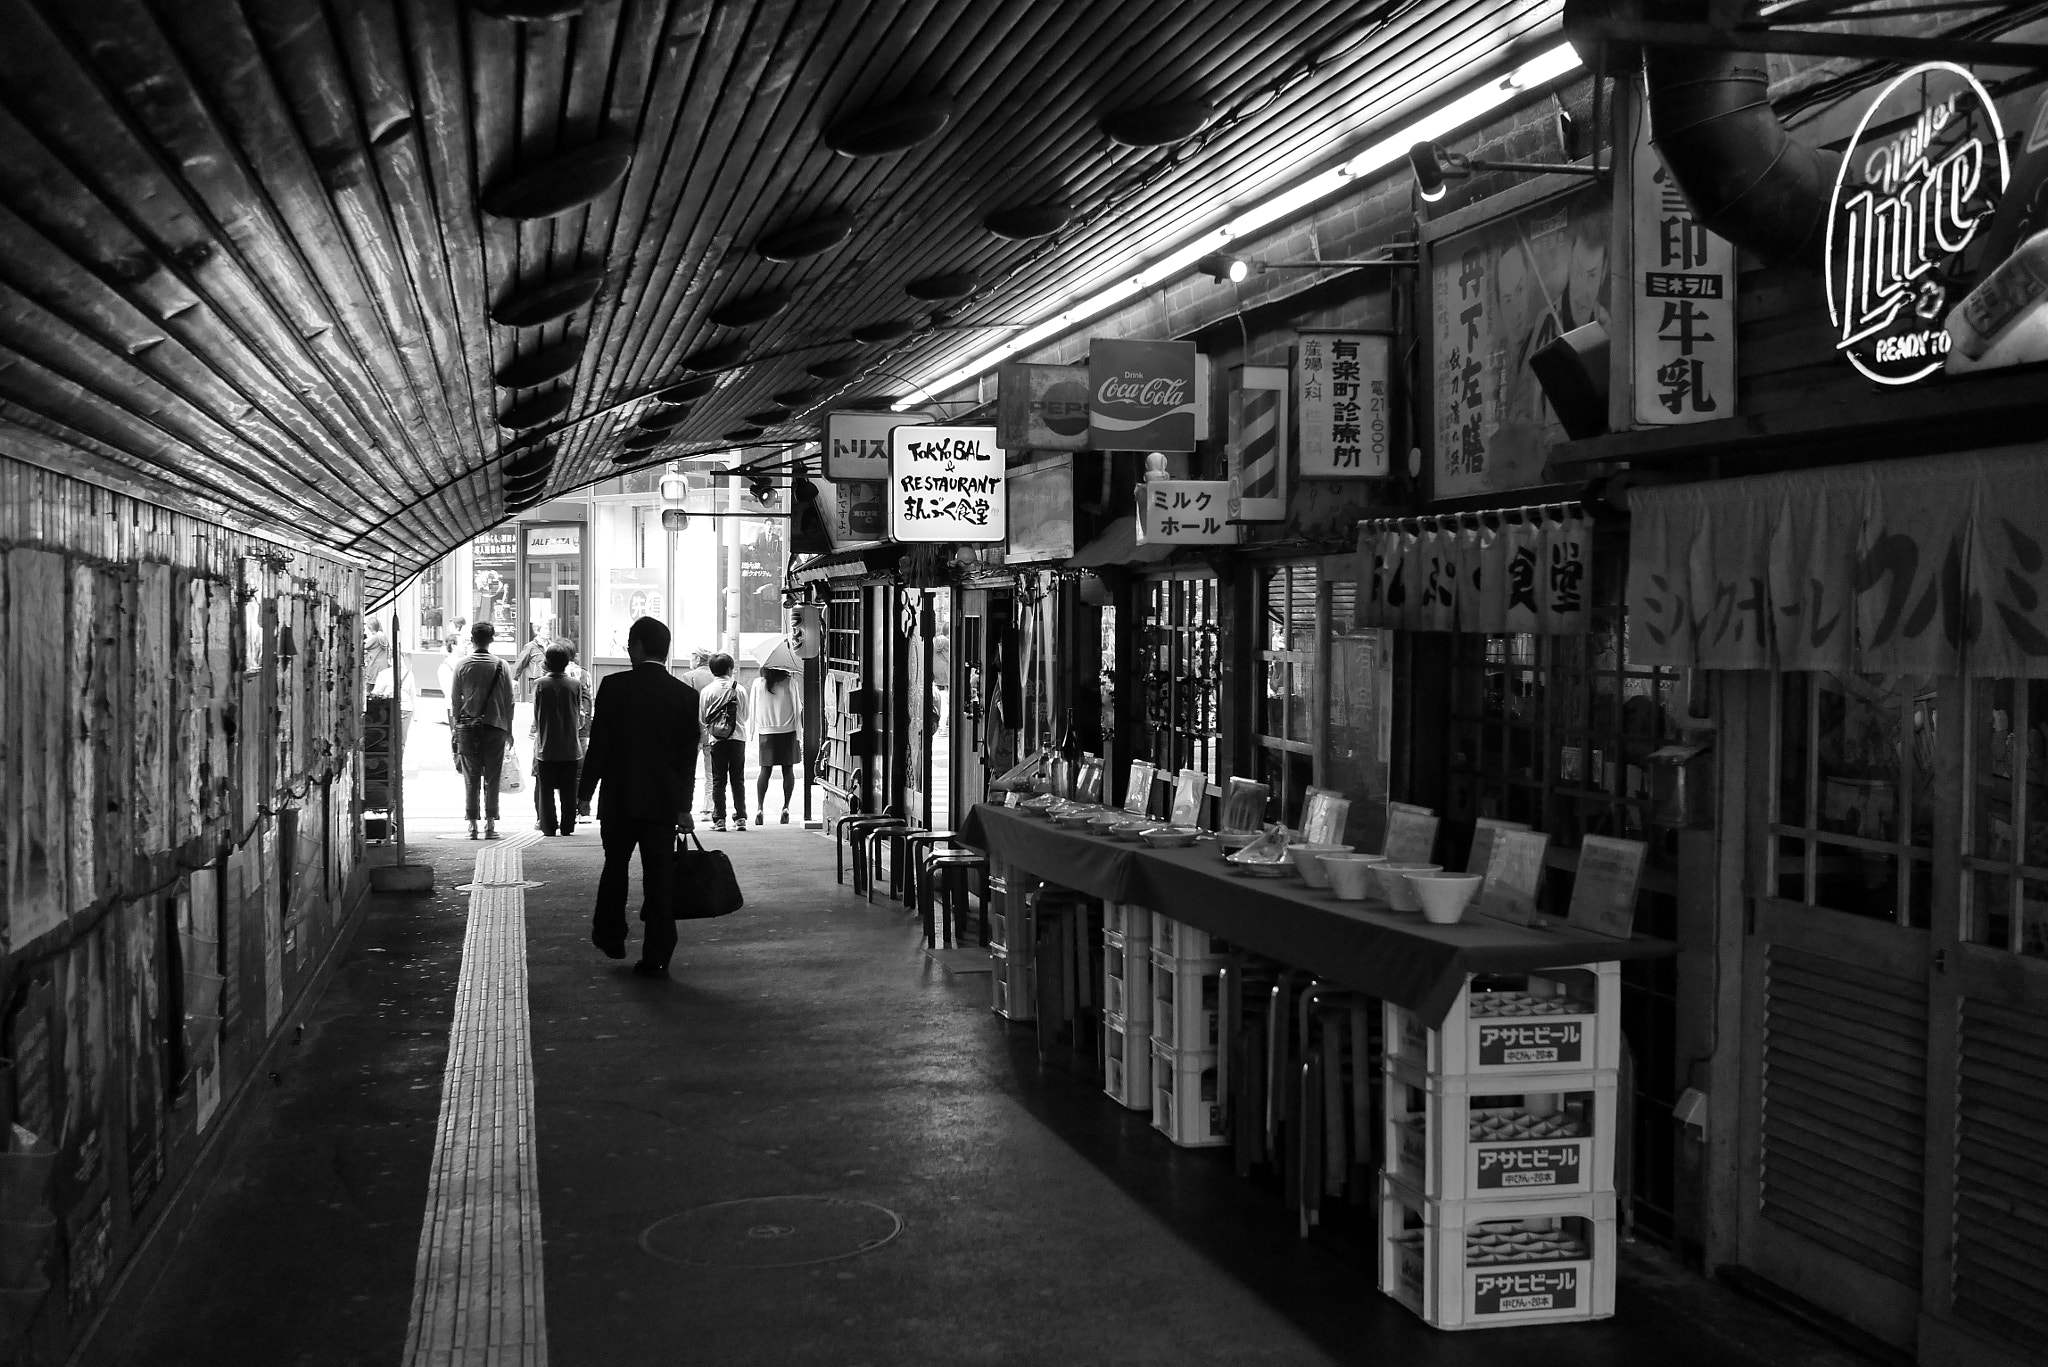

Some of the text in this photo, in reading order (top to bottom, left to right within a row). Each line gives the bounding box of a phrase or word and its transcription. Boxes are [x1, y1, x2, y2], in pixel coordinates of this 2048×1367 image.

[1865, 91, 1960, 194] Miller
[1836, 137, 1995, 350] Lite
[1652, 277, 1717, 295] ミネラル
[1657, 300, 1717, 415] 牛乳
[1876, 329, 1952, 363] READY TO
[1304, 340, 1323, 402] 産婦人科
[1458, 246, 1485, 475] 丹下左膳
[1124, 371, 1144, 380] Drink
[1098, 376, 1188, 406] Coca-Cola
[1331, 339, 1361, 468] 有楽町診療所
[833, 439, 888, 459] トリス
[954, 440, 990, 461] BAL
[901, 475, 1002, 498] RESTAURANT
[904, 496, 990, 525] まんぷく食堂
[1155, 491, 1212, 511] ミルク
[1161, 517, 1221, 536] ホール
[1371, 542, 1583, 614] んぷ食堂
[1481, 1025, 1580, 1047] アサヒビール
[1479, 1148, 1578, 1170] アサヒビール
[1477, 1272, 1575, 1295] アサヒビール
